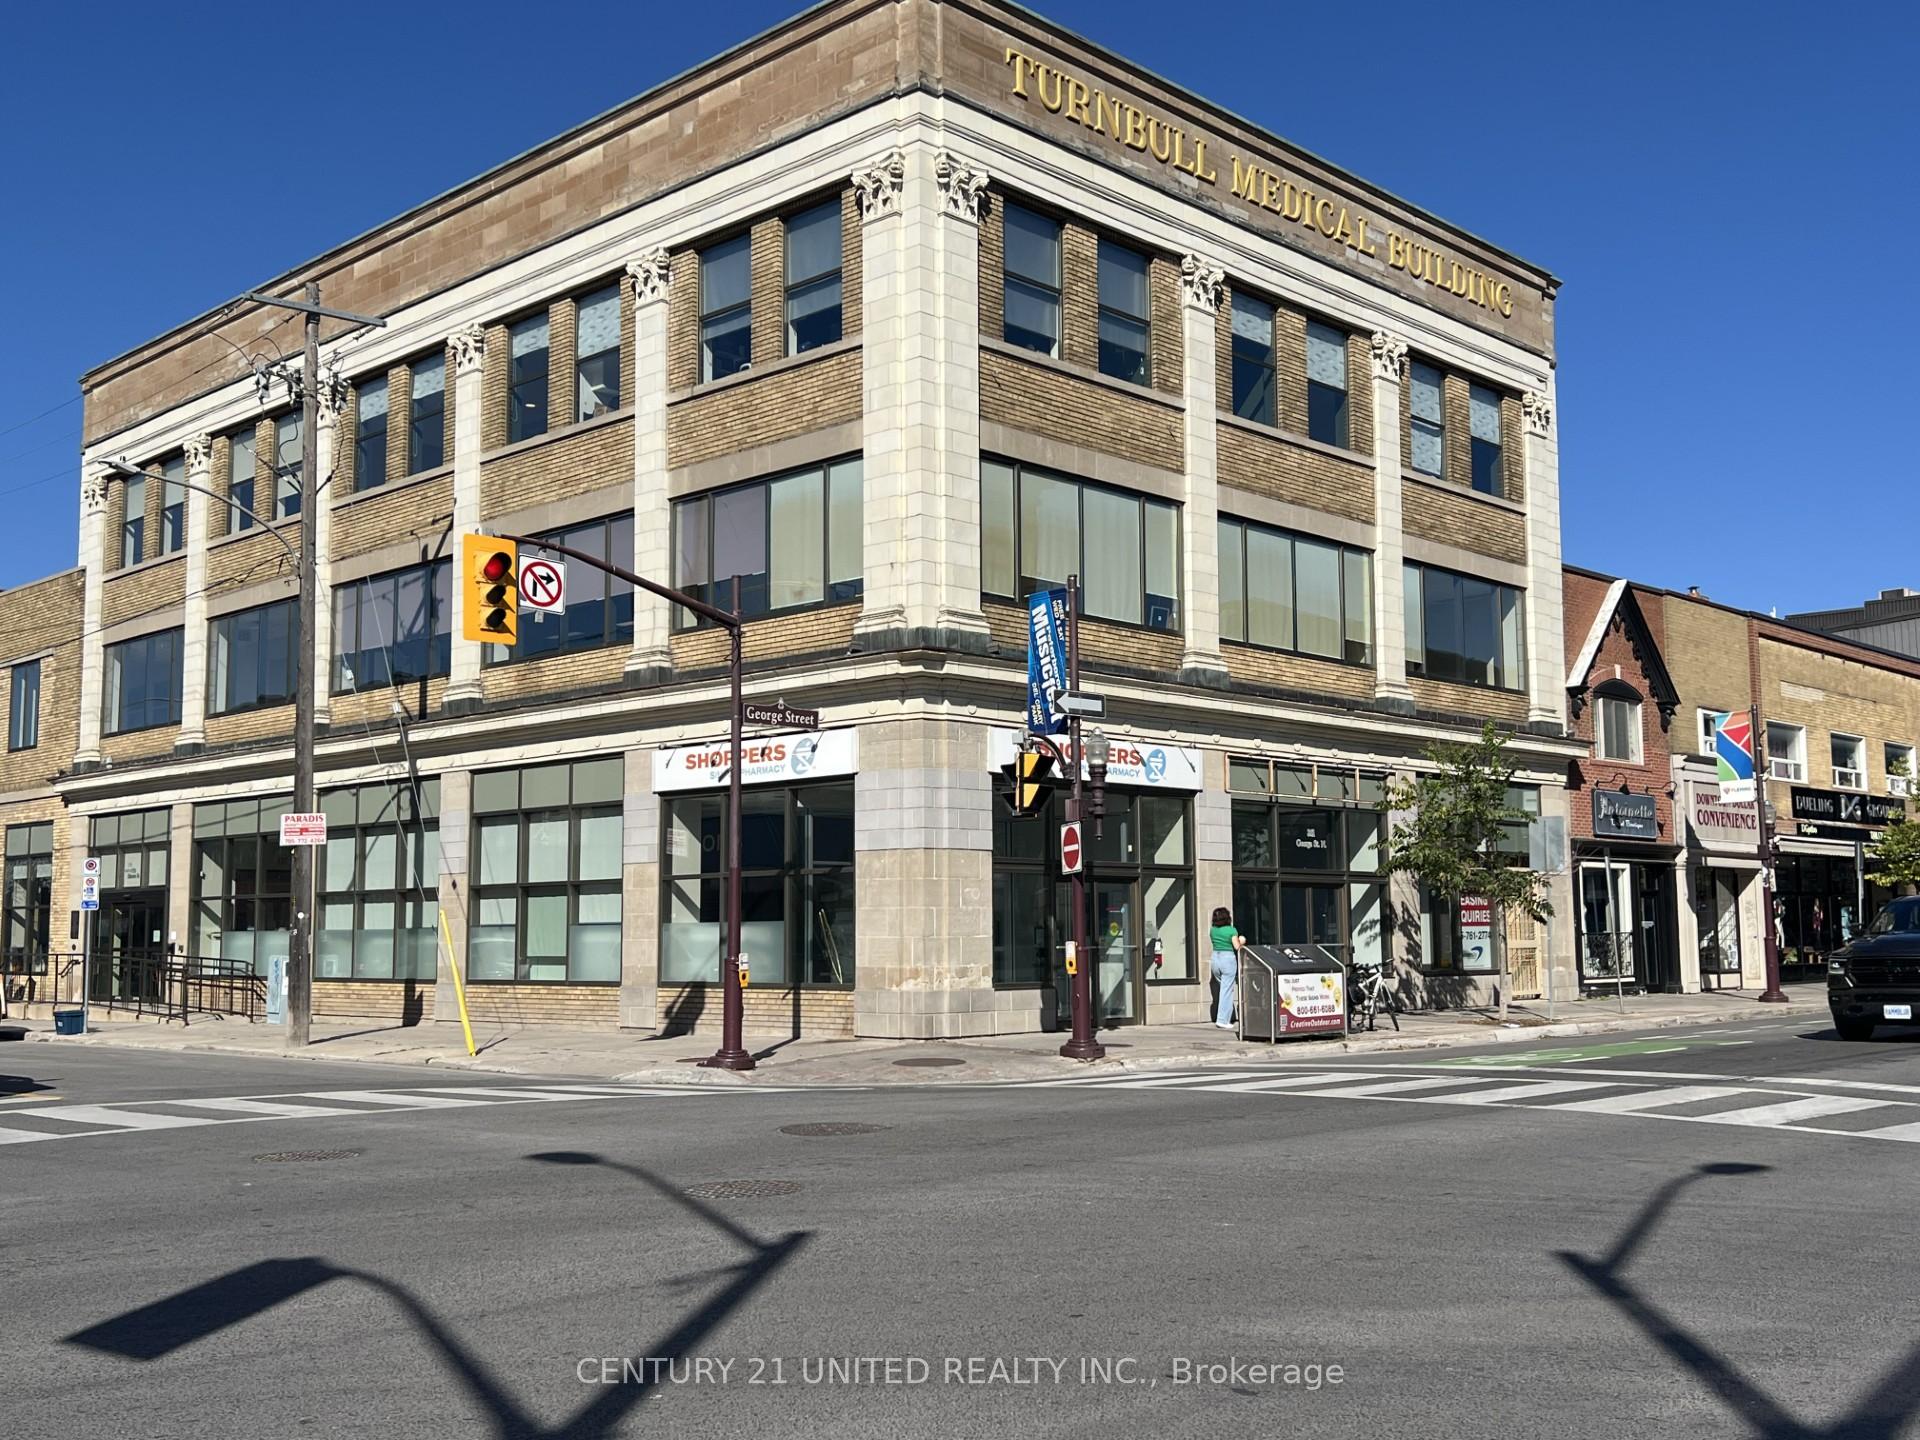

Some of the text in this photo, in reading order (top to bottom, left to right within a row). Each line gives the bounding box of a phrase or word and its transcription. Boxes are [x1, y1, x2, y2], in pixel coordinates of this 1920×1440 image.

[1005, 47, 1513, 319] TURNBULL MEDICAL BUILDING
[1047, 625, 1062, 691] Peterboro
[746, 706, 815, 725] George Street
[685, 744, 786, 770] SHOPPERS
[1106, 766, 1140, 778] ARMACY
[1696, 792, 1729, 808] DOWNT
[1795, 795, 1834, 813] DUELING
[284, 814, 324, 823] PARADIS
[1696, 809, 1757, 830] CONVENIENCE
[1290, 1018, 1341, 1029] CreativeOutdoor.com
